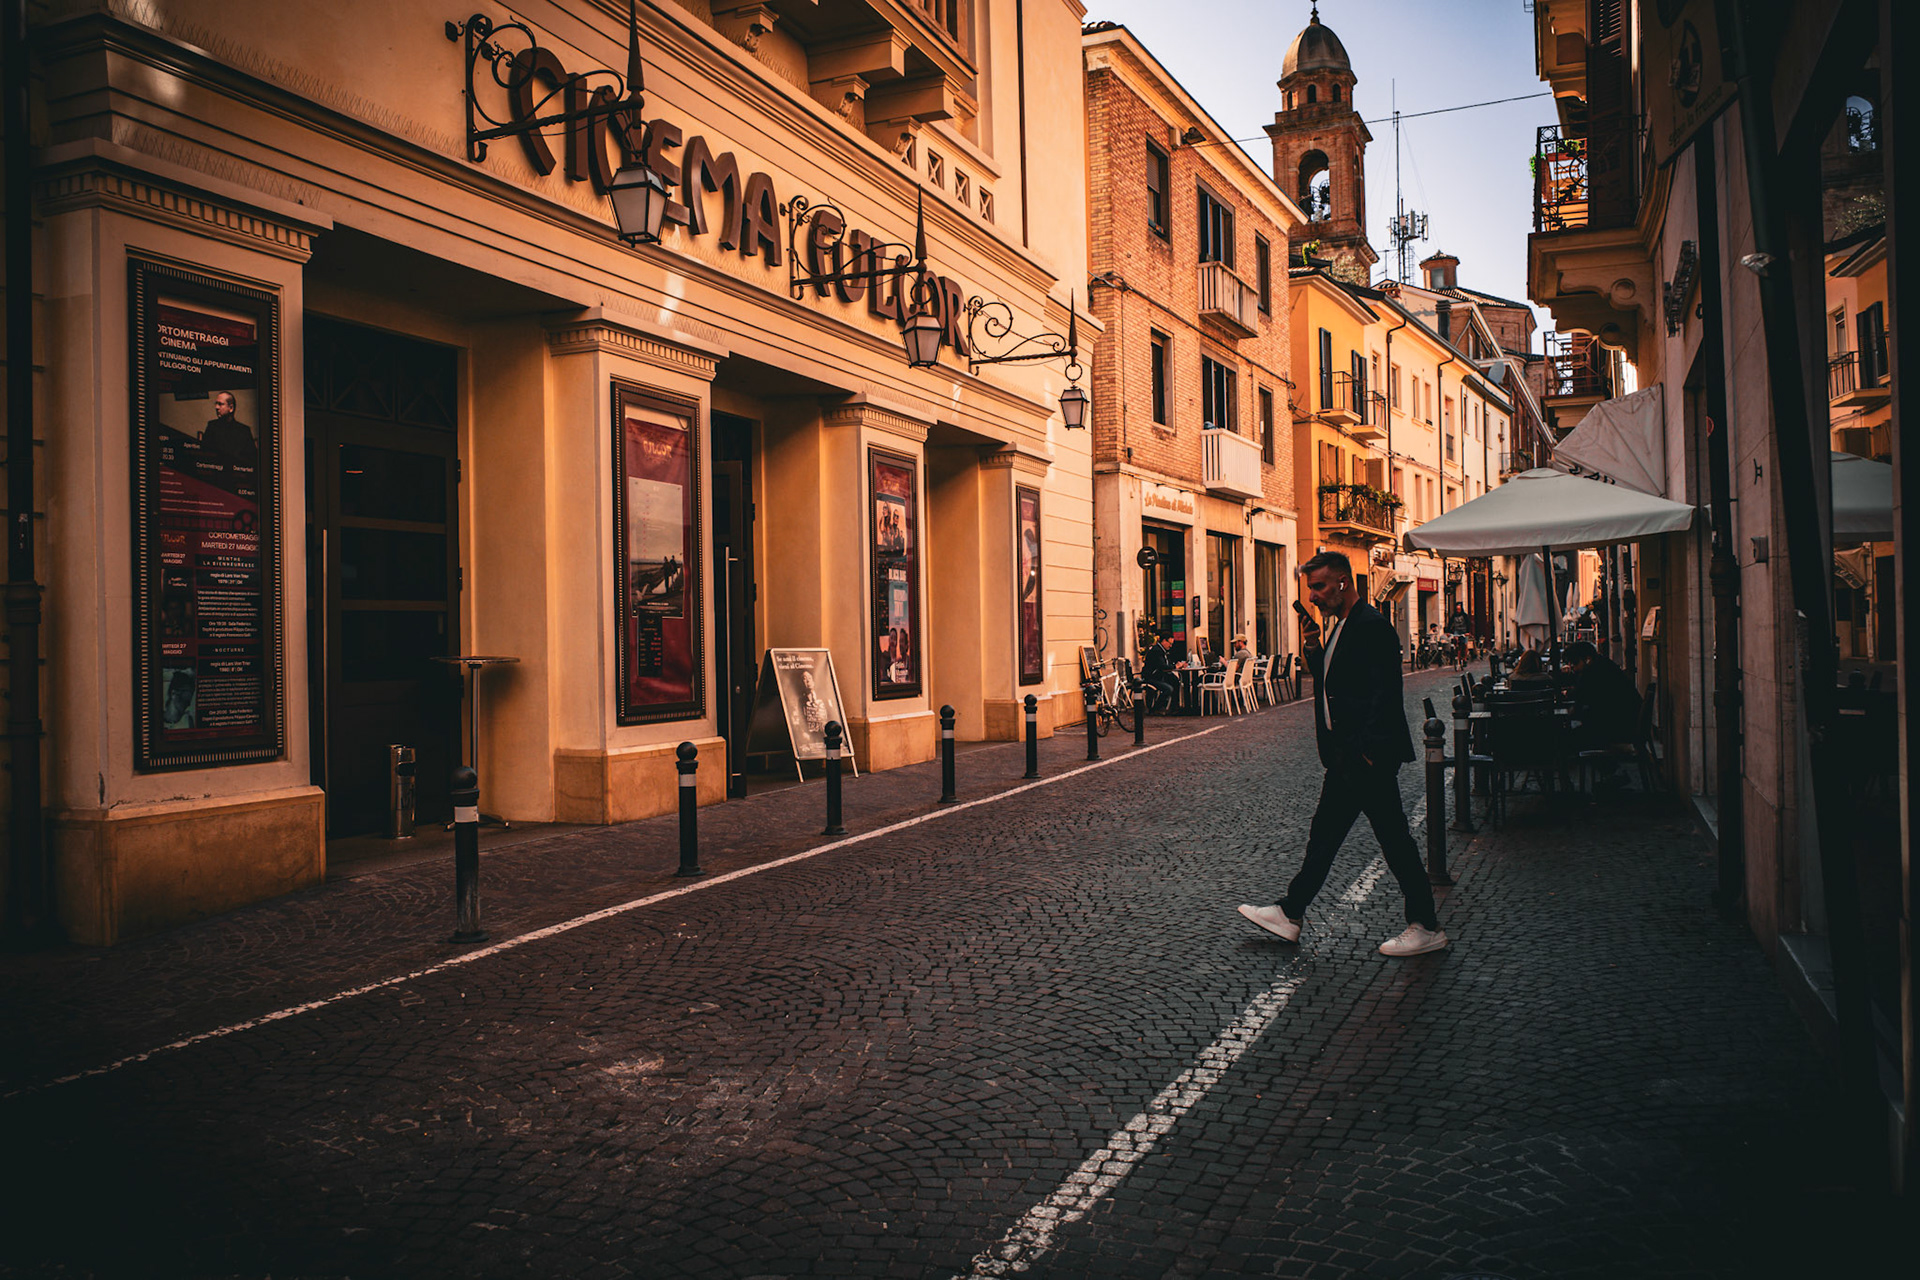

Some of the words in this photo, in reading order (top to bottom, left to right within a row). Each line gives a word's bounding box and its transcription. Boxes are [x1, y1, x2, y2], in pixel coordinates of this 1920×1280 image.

[510, 47, 782, 267] CINEMA
[806, 209, 970, 357] FULGOR
[160, 336, 197, 351] CINEMA
[160, 360, 187, 370] FULGOR
[187, 365, 201, 374] CON
[192, 357, 202, 365] GLI
[204, 360, 252, 374] APPUNTAMENTI
